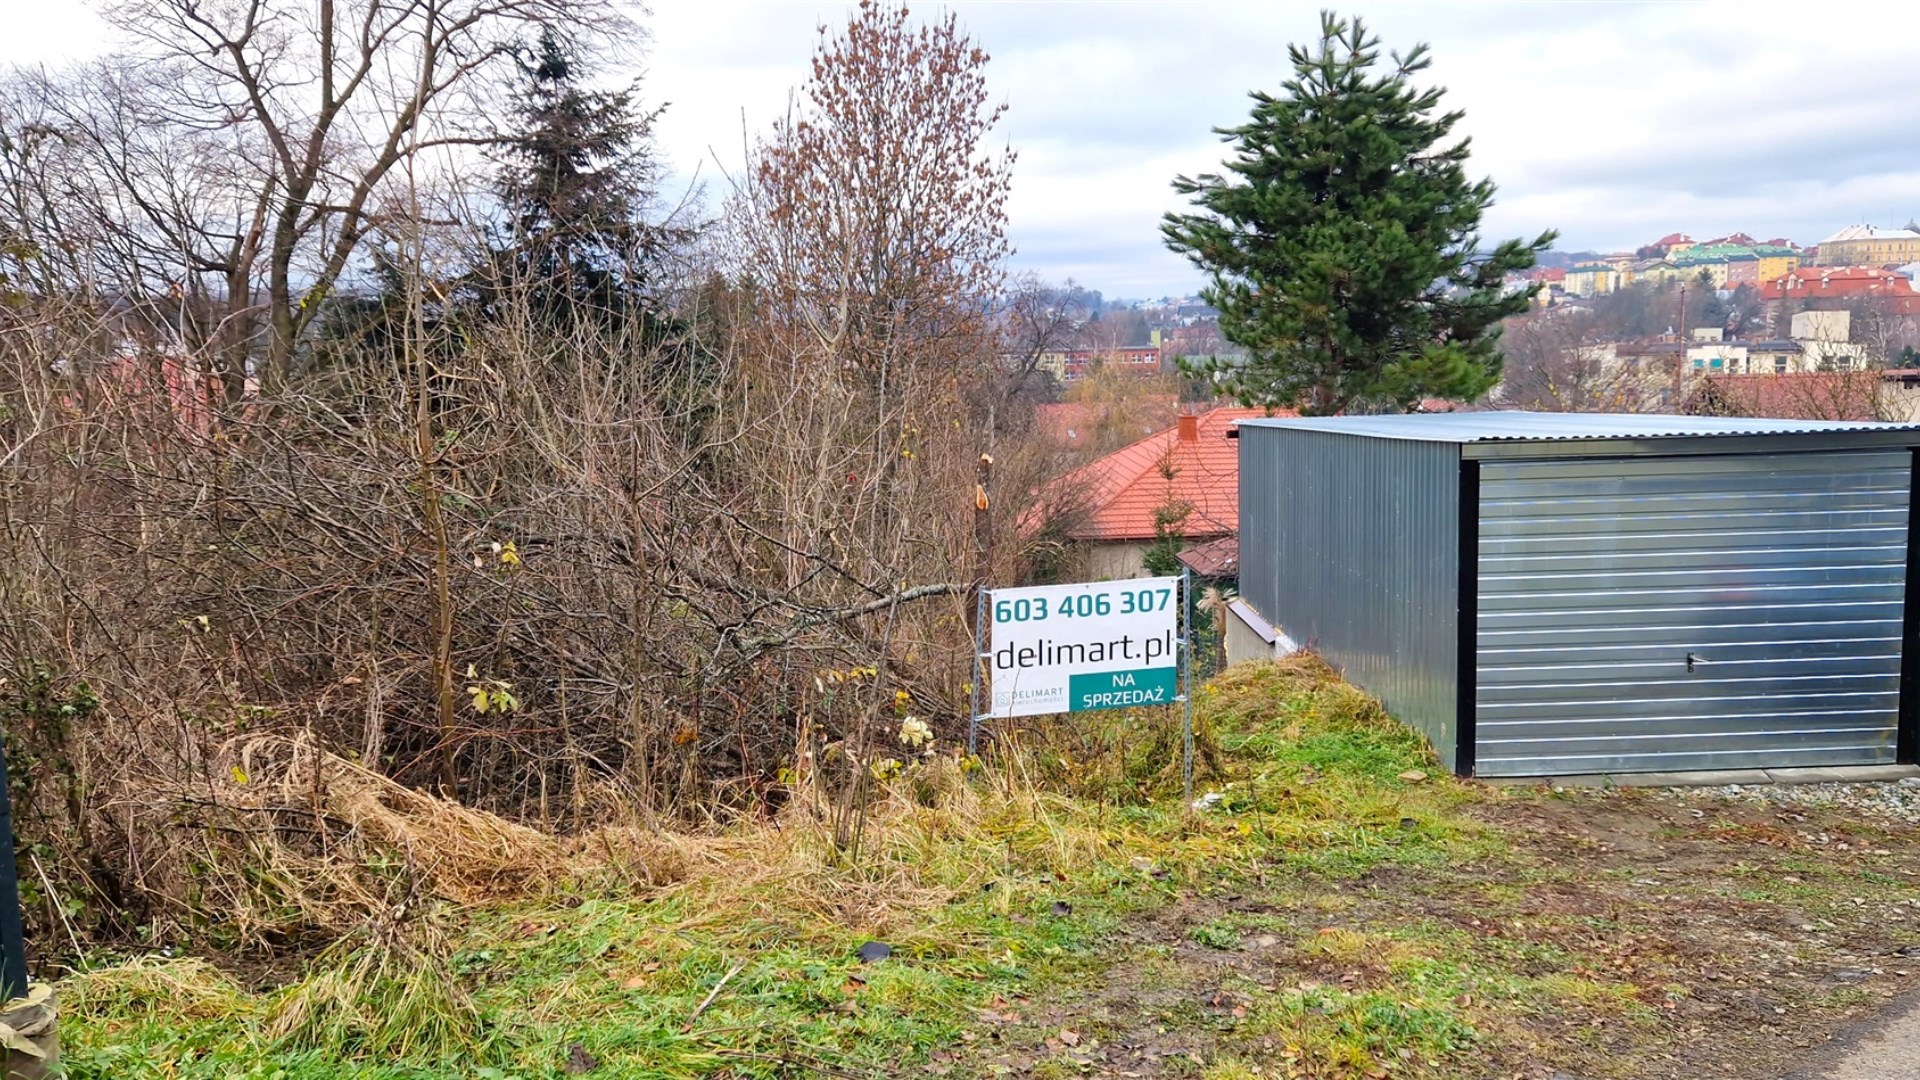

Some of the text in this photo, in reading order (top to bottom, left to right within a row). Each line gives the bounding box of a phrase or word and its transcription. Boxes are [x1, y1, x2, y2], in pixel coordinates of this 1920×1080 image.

[995, 589, 1171, 623] 603 406 307
[996, 629, 1171, 670] delimart.pl
[1112, 673, 1135, 687] NA
[1012, 687, 1063, 699] DELIMART
[1083, 686, 1164, 708] SPRZEDAŻ
